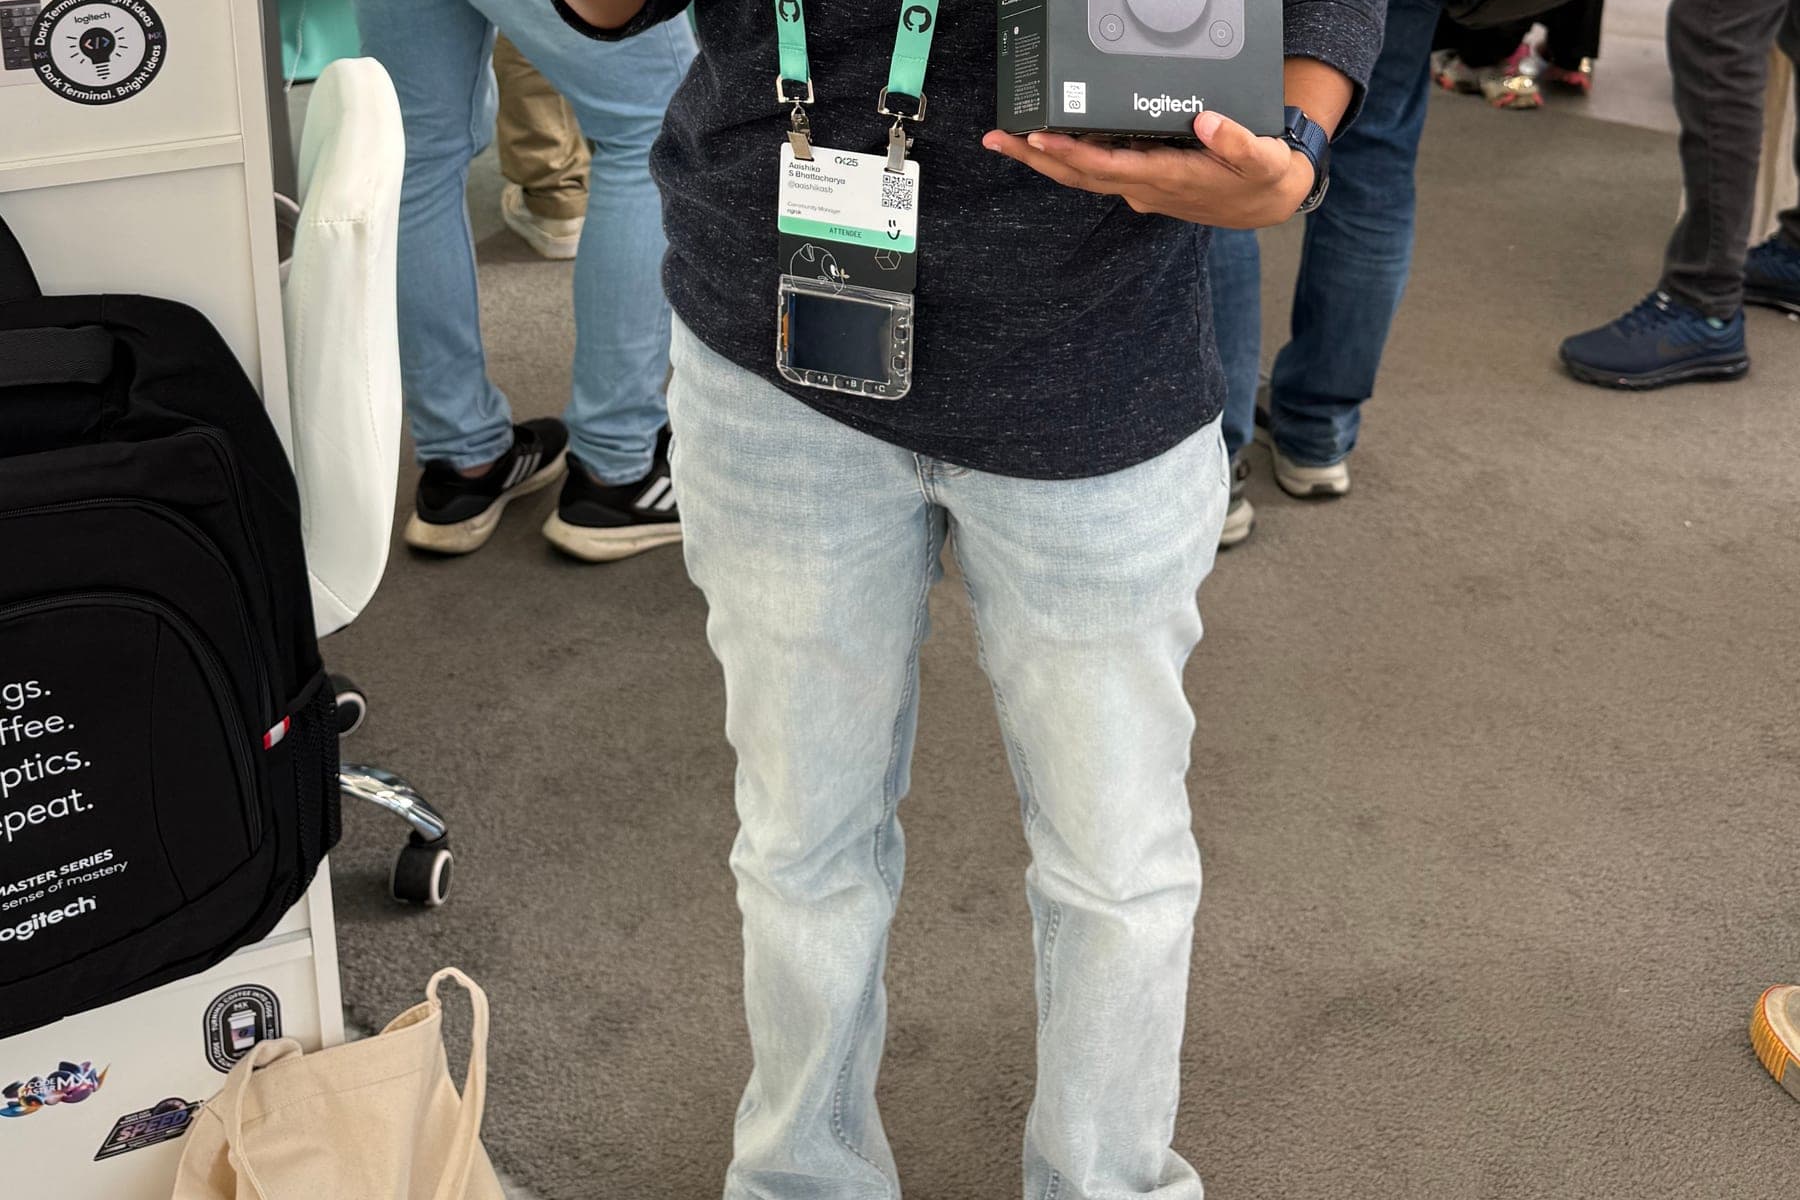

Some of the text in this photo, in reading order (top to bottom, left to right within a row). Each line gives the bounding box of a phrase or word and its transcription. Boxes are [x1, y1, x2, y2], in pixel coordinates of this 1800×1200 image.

[34, 19, 52, 46] Dark
[131, 2, 155, 28] Ideas
[74, 12, 111, 25] logitech
[40, 45, 162, 101] Dark Terminal. Bright Ideas
[1133, 92, 1204, 118] logitech
[788, 162, 821, 173] Aaishika
[788, 169, 846, 185] S Bhattacharya
[829, 227, 862, 239] ATTENDEE
[821, 375, 829, 384] A
[2, 680, 51, 710] gs.
[0, 714, 75, 746] ffee.
[0, 750, 91, 798] ptics.
[0, 789, 94, 842] peat.
[59, 849, 114, 876] SERIES
[2, 860, 129, 911] sense of mastery
[0, 895, 97, 941] ogitech
[233, 1001, 249, 1011] MX
[57, 1070, 92, 1091] MX
[116, 1110, 188, 1141] SPEED
